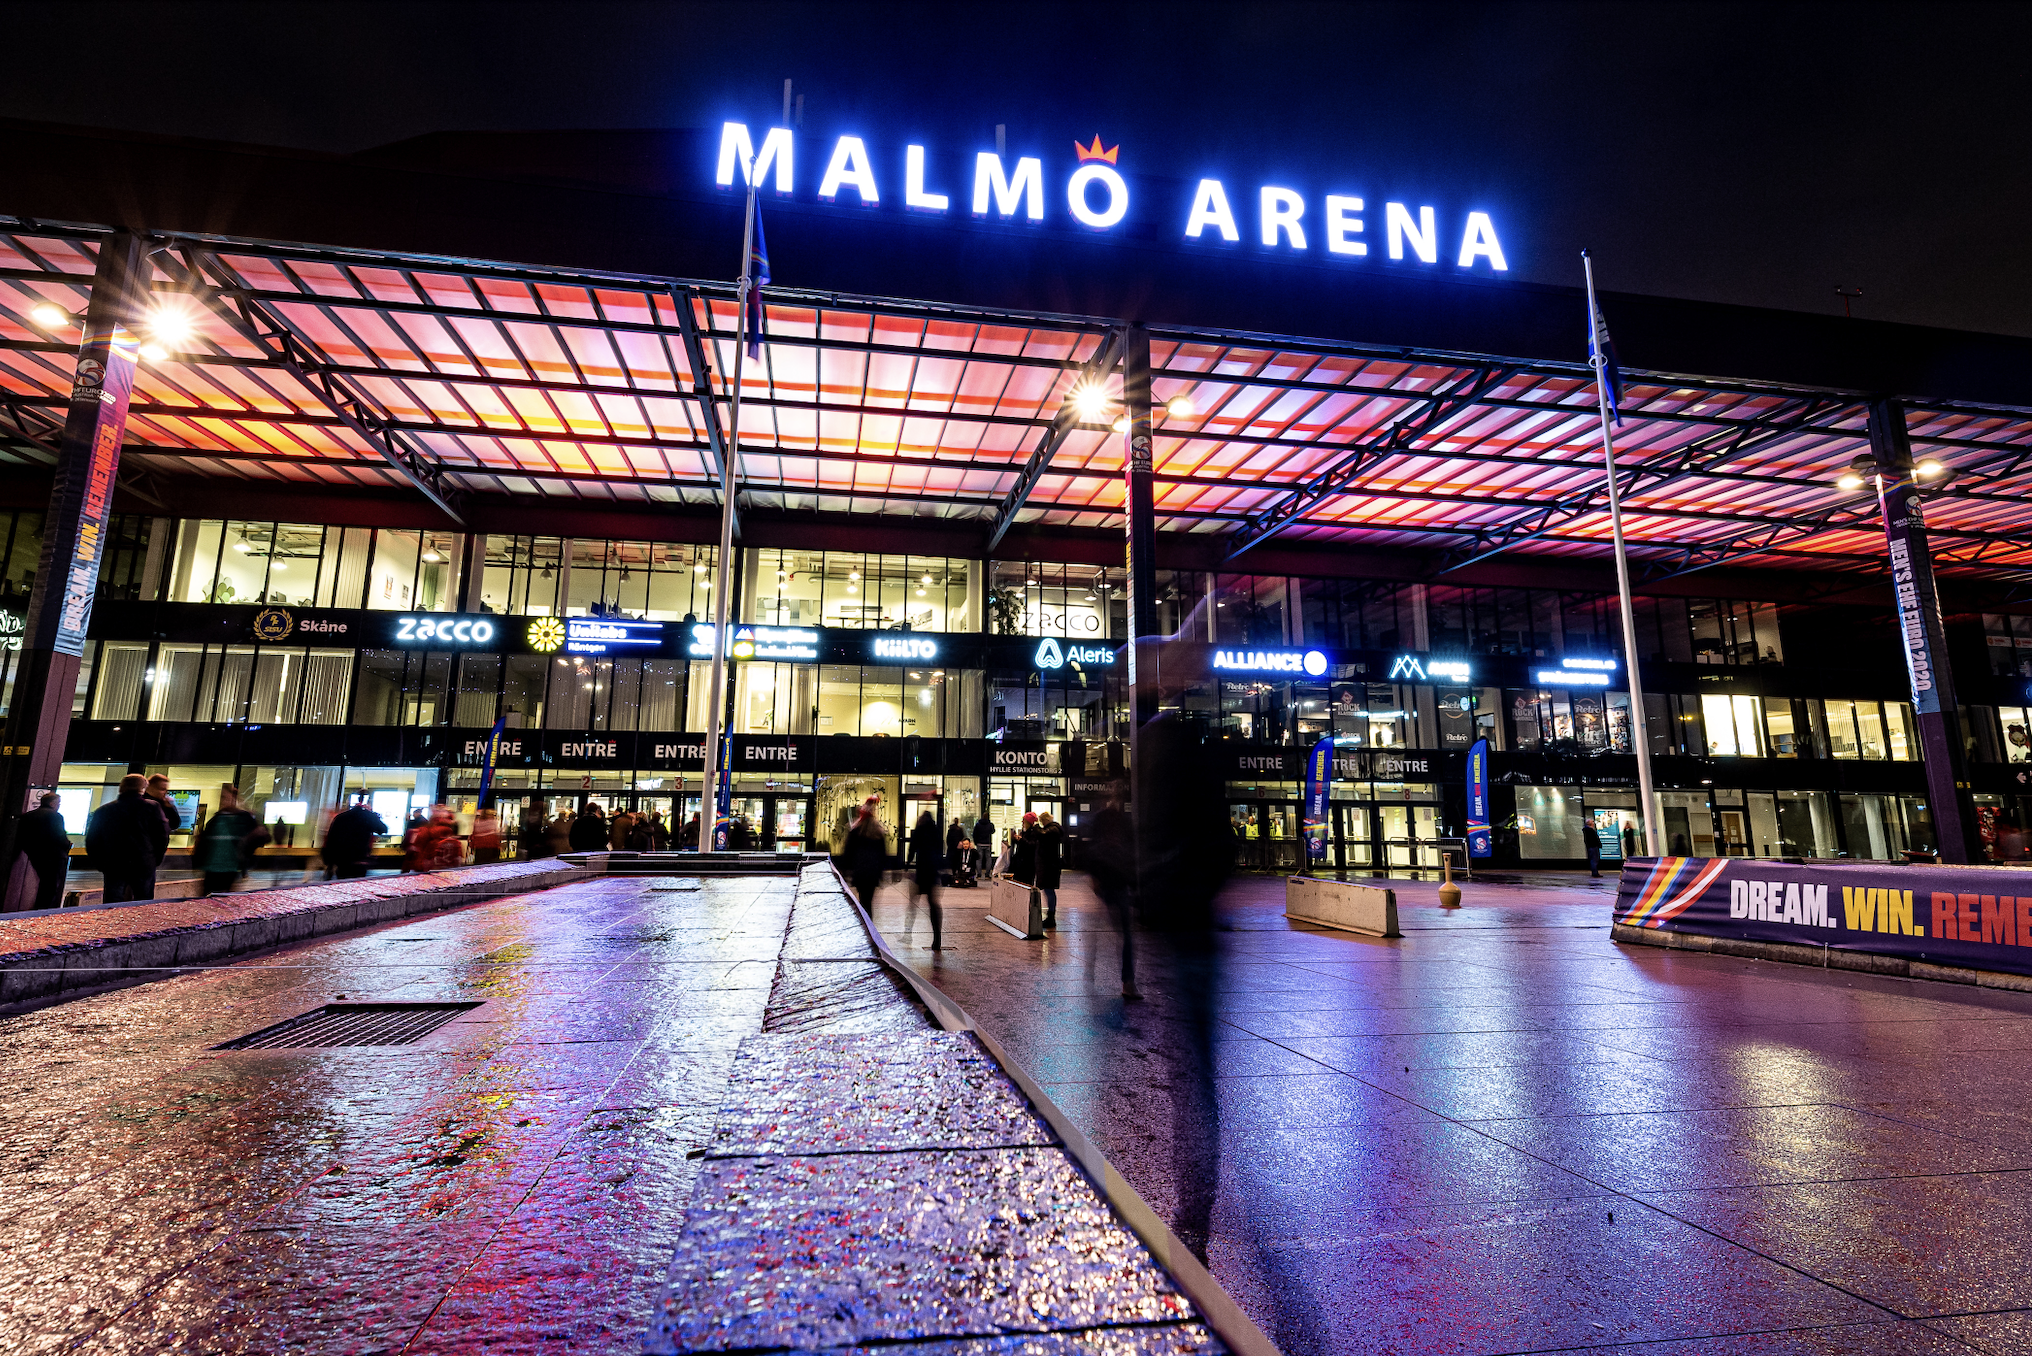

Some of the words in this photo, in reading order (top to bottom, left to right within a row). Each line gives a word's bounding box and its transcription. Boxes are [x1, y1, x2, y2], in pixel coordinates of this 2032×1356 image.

[1184, 178, 1509, 271] ARENA
[85, 423, 119, 520] REMEMBER.
[77, 522, 100, 562] WIN.
[300, 619, 348, 633] Skåne
[568, 622, 627, 639] Unilabs
[1904, 610, 1925, 650] EURO
[1066, 645, 1114, 664] Aleris
[1213, 650, 1304, 671] ALLIANCE
[1911, 650, 1932, 691] 2020
[1337, 703, 1360, 711] ROCK
[1511, 708, 1534, 717] ROCK
[582, 776, 591, 789] 2
[674, 777, 683, 790] 3
[1257, 787, 1265, 798] 6
[1404, 788, 1412, 800] 8
[1729, 879, 1837, 929] DREAM.
[1842, 886, 1925, 938] WIN.
